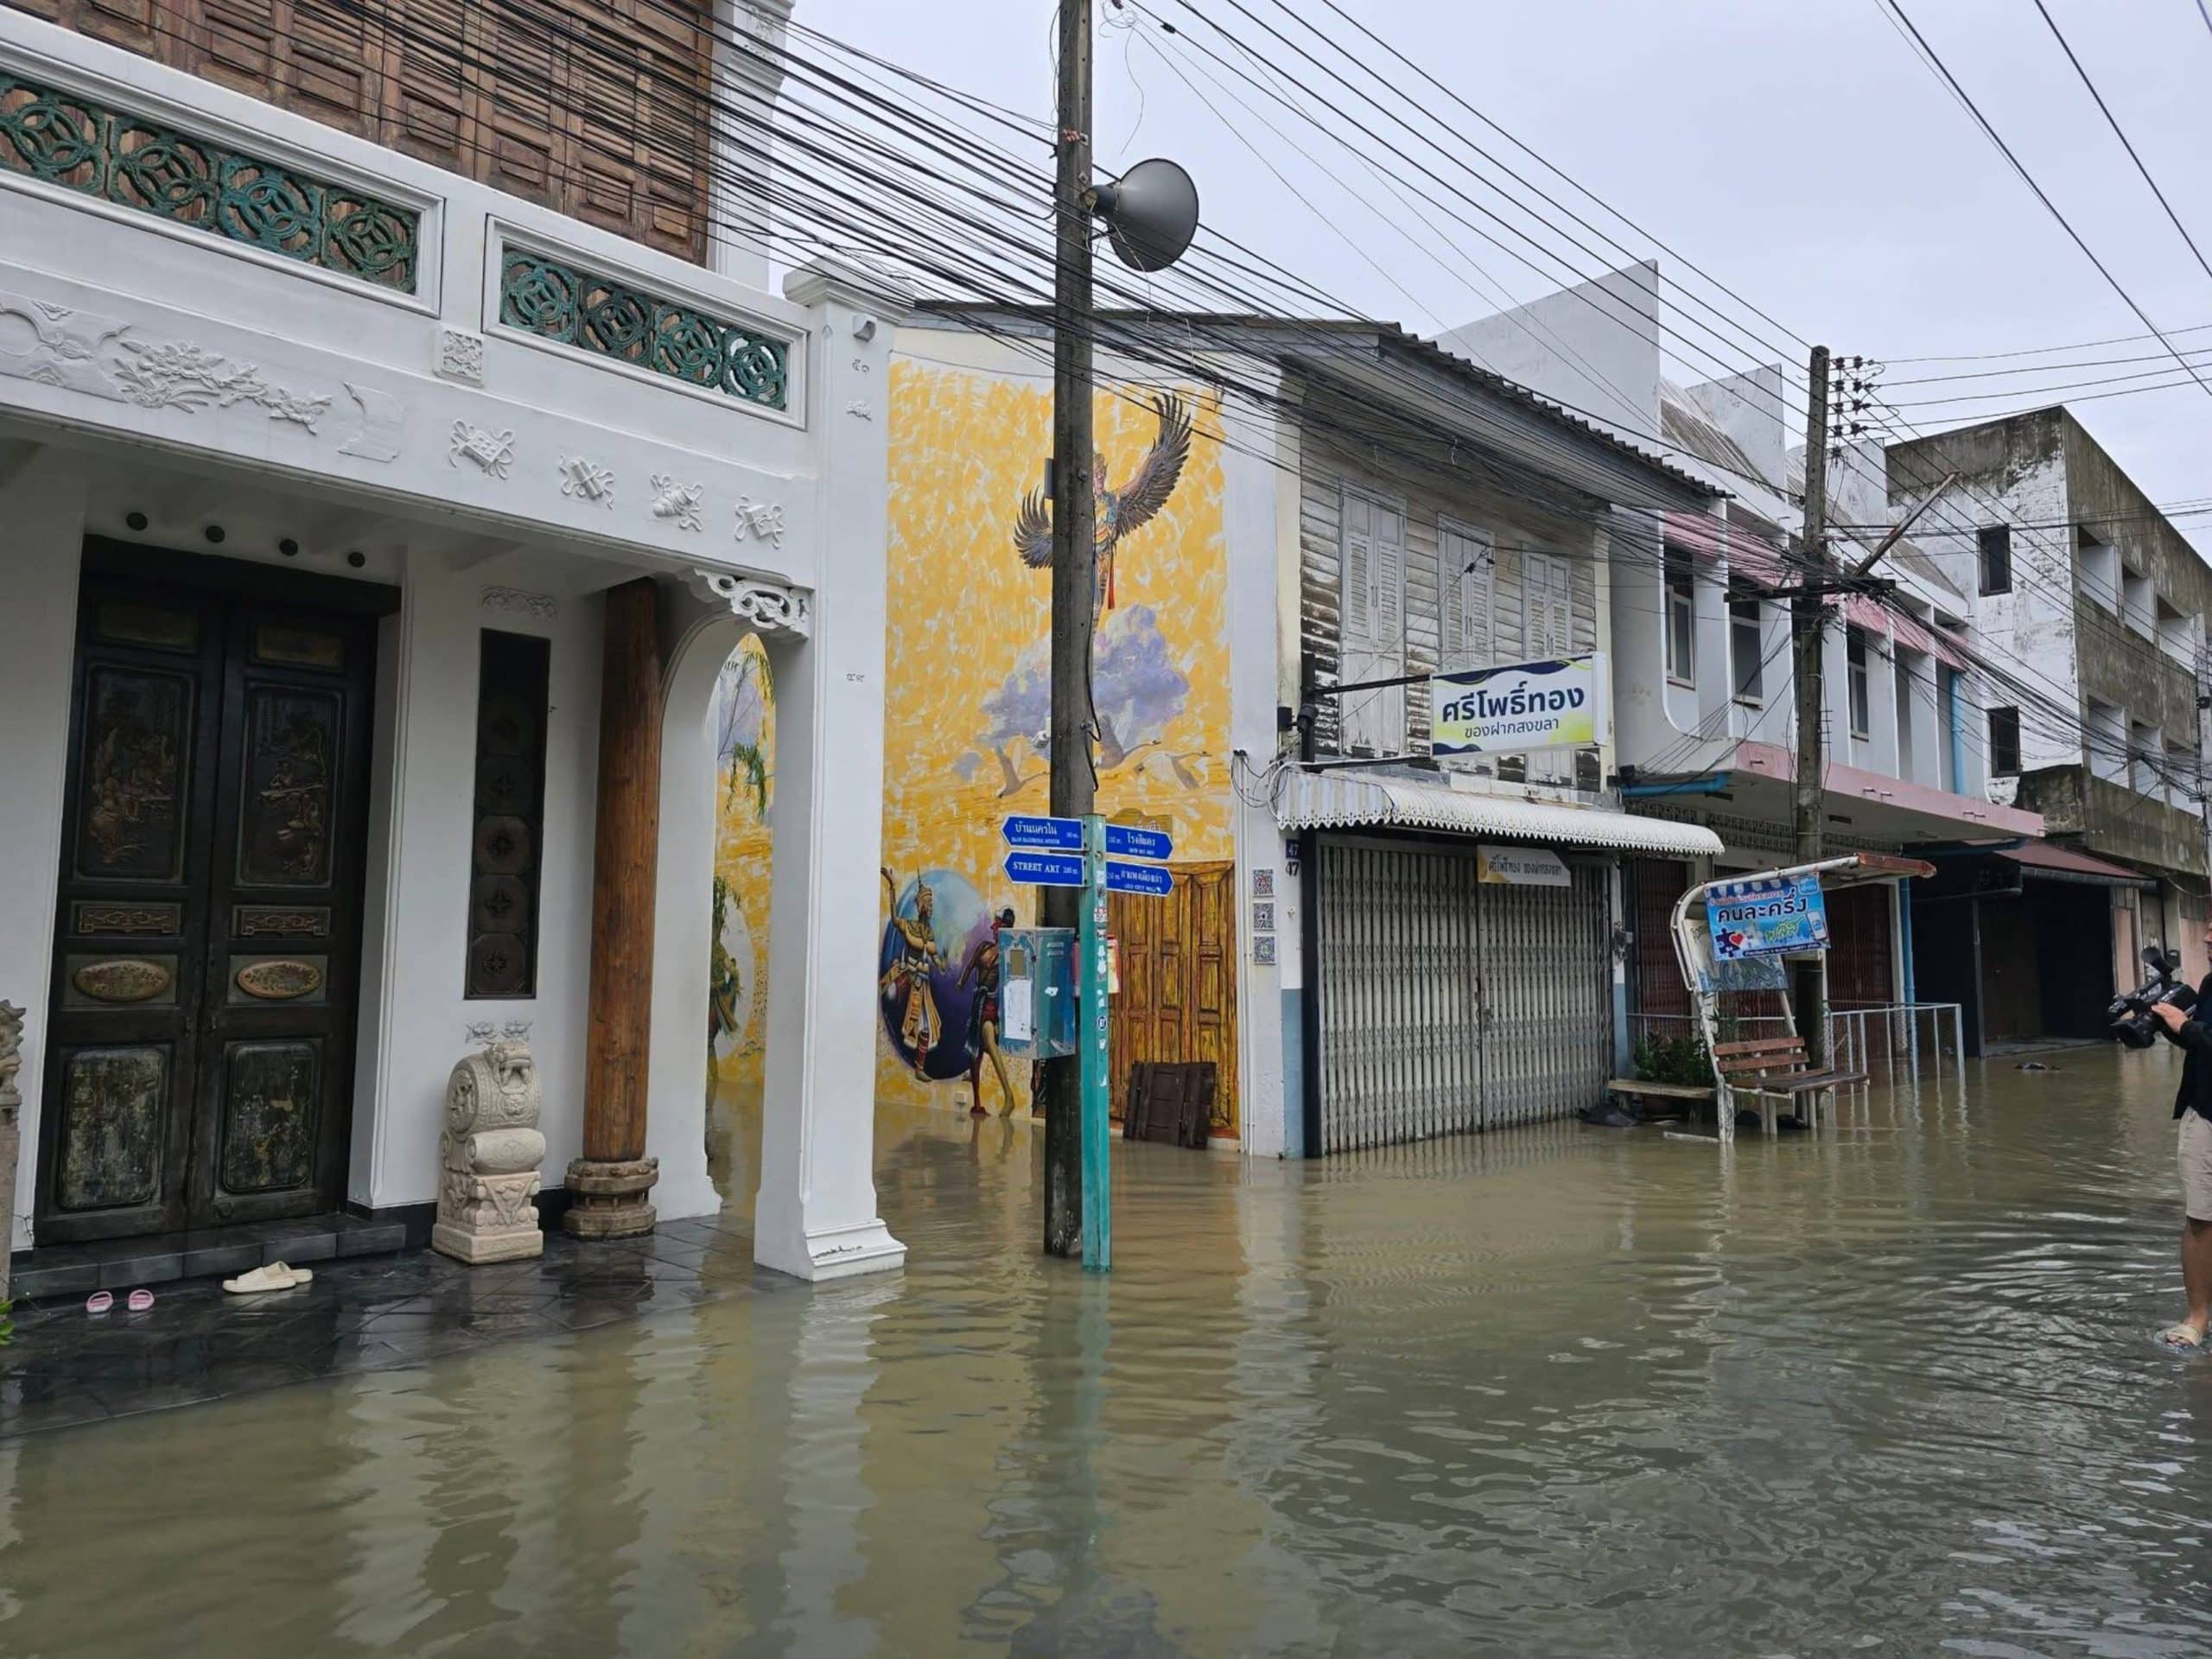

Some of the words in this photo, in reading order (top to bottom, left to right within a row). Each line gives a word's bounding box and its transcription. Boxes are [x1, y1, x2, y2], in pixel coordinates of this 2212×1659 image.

[1442, 680, 1585, 722] ศรีโพธิ์ทอง
[1465, 718, 1559, 739] ของฝากสงขลา
[1288, 844, 1299, 855] 47
[1013, 861, 1043, 872] STREET
[1044, 864, 1061, 874] ART
[1286, 861, 1300, 876] 47
[1717, 887, 1808, 924] คนละครึ่ง
[1765, 916, 1807, 943] พลัส
